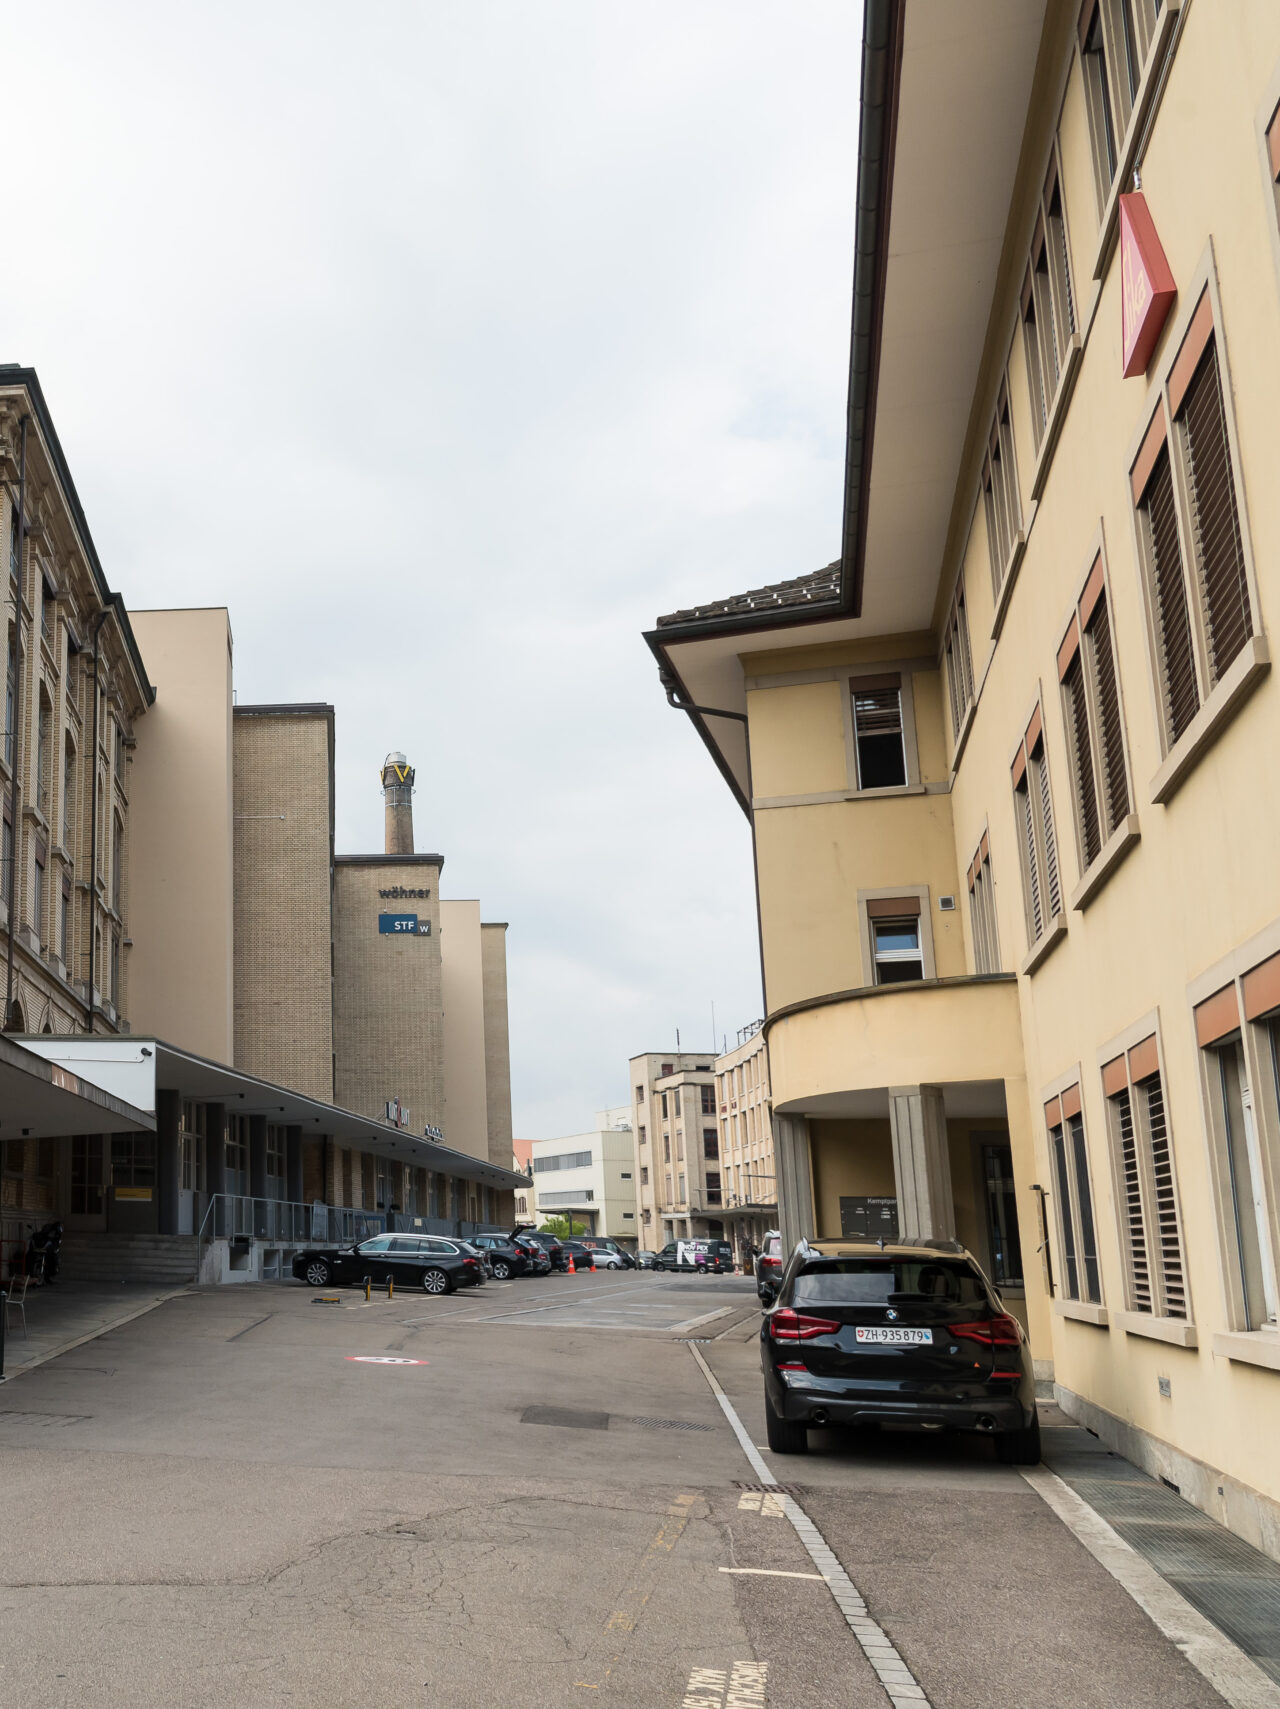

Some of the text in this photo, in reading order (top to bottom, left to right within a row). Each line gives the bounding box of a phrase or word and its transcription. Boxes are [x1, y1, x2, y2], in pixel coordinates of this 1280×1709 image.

[378, 885, 431, 900] wöhner
[394, 921, 415, 931] STF
[867, 1198, 897, 1206] Kemptpar
[724, 1660, 768, 1709] UMSCHLA
